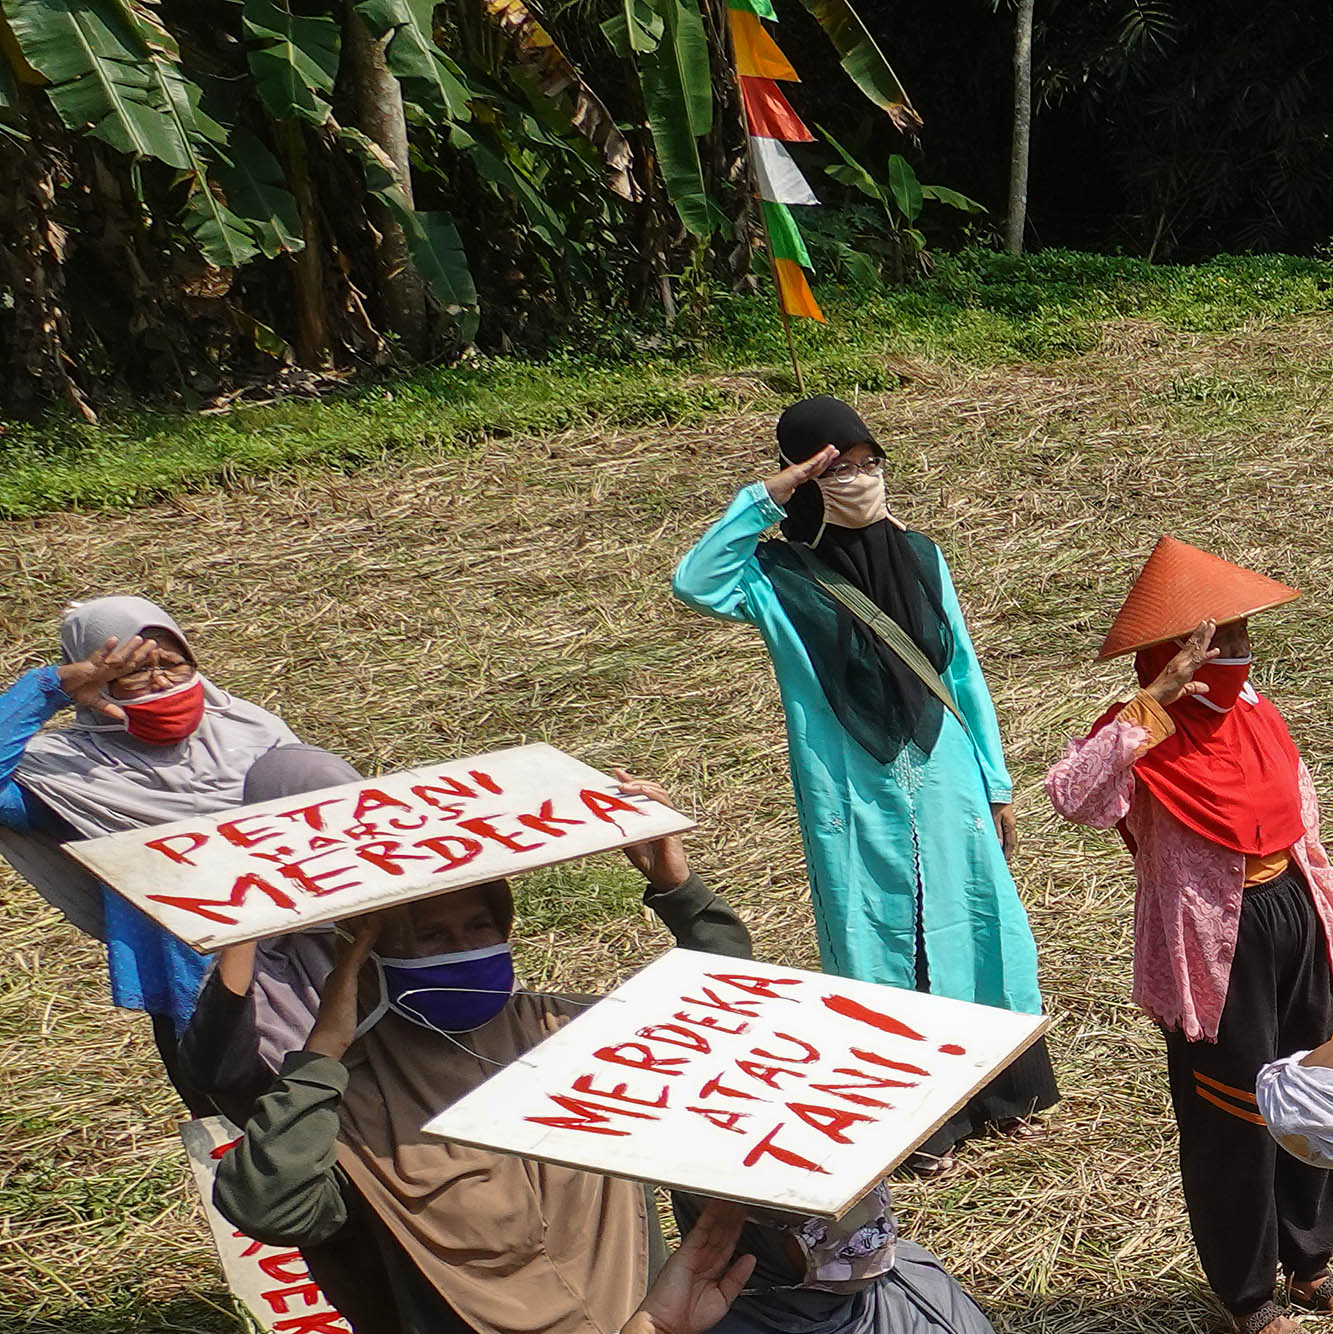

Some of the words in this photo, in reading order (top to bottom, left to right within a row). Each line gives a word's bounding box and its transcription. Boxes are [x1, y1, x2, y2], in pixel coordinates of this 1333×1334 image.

[146, 769, 504, 866] PETANI
[146, 788, 646, 925] MERDEKA
[250, 803, 466, 864] HARUS
[523, 972, 803, 1136] MERDEKA
[687, 1032, 820, 1134] ATAU
